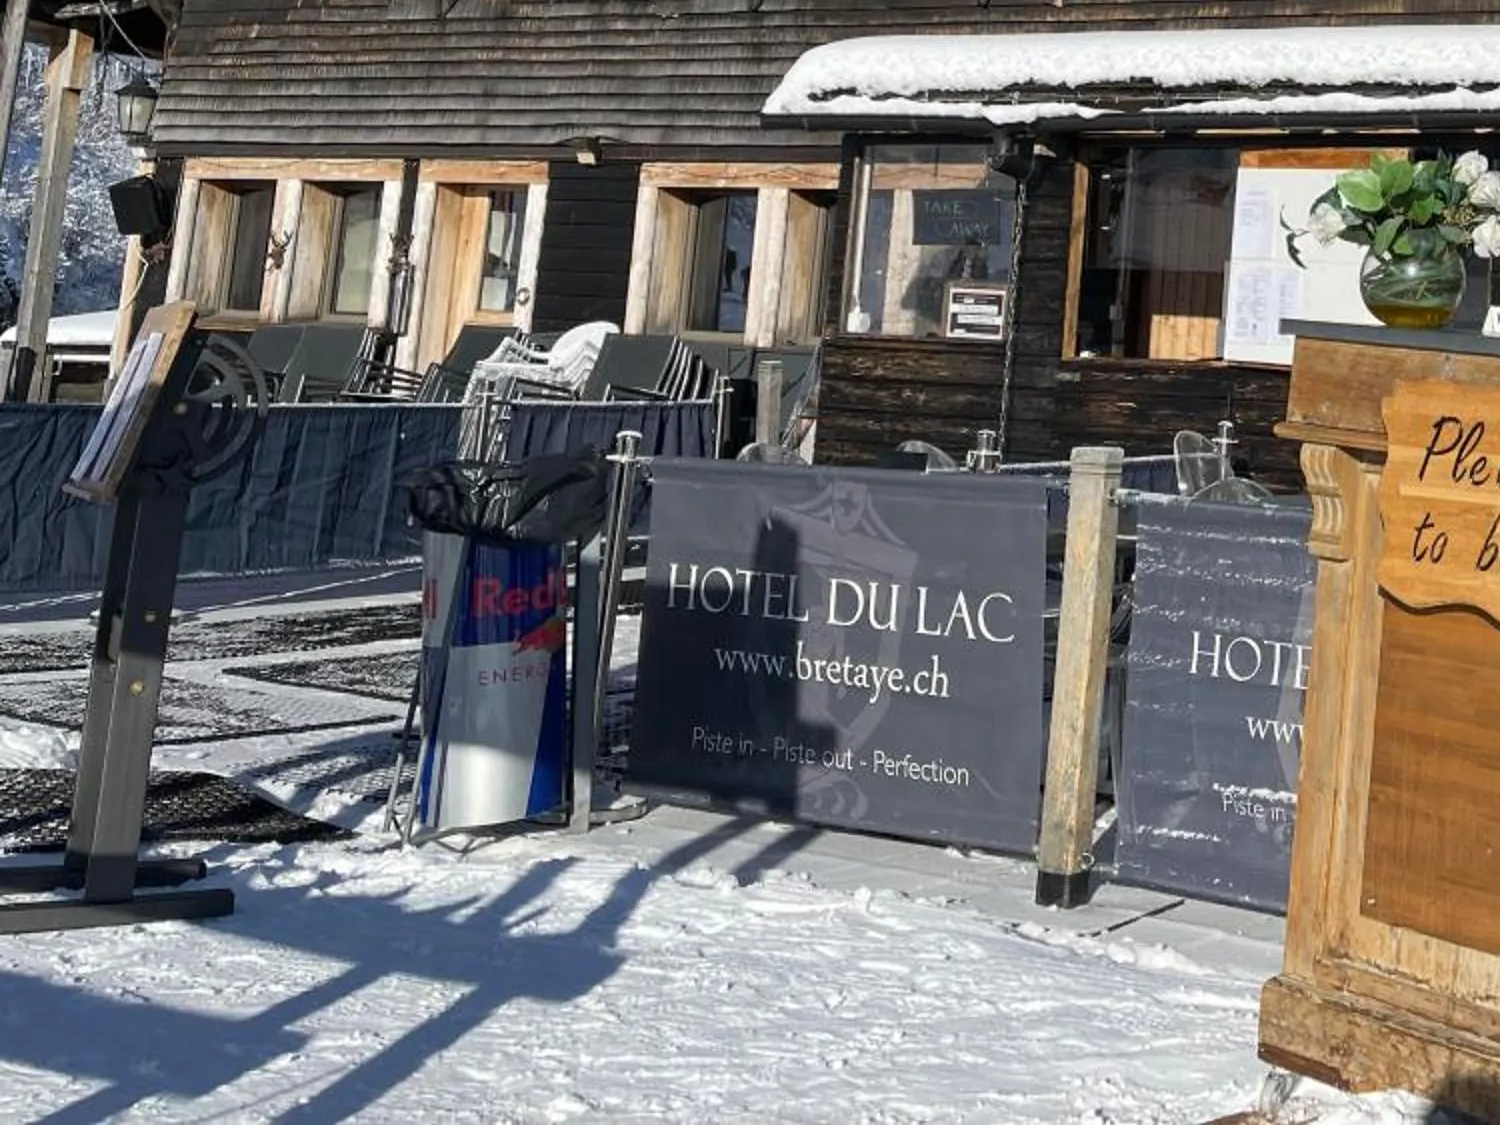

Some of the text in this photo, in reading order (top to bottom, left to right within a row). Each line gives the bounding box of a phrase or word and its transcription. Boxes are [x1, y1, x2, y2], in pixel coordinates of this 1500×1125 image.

[1413, 513, 1447, 563] to
[667, 562, 1015, 643] HOTEL DU LAC
[478, 661, 547, 687] ENERG
[714, 640, 950, 703] www.bretaye.ch
[1189, 631, 1312, 690] HOTE
[691, 726, 734, 755] Piste
[739, 737, 754, 757] in
[773, 736, 817, 766] Piste
[822, 748, 854, 771] out
[872, 750, 970, 787] Perfection
[1221, 791, 1287, 823] Piste in
